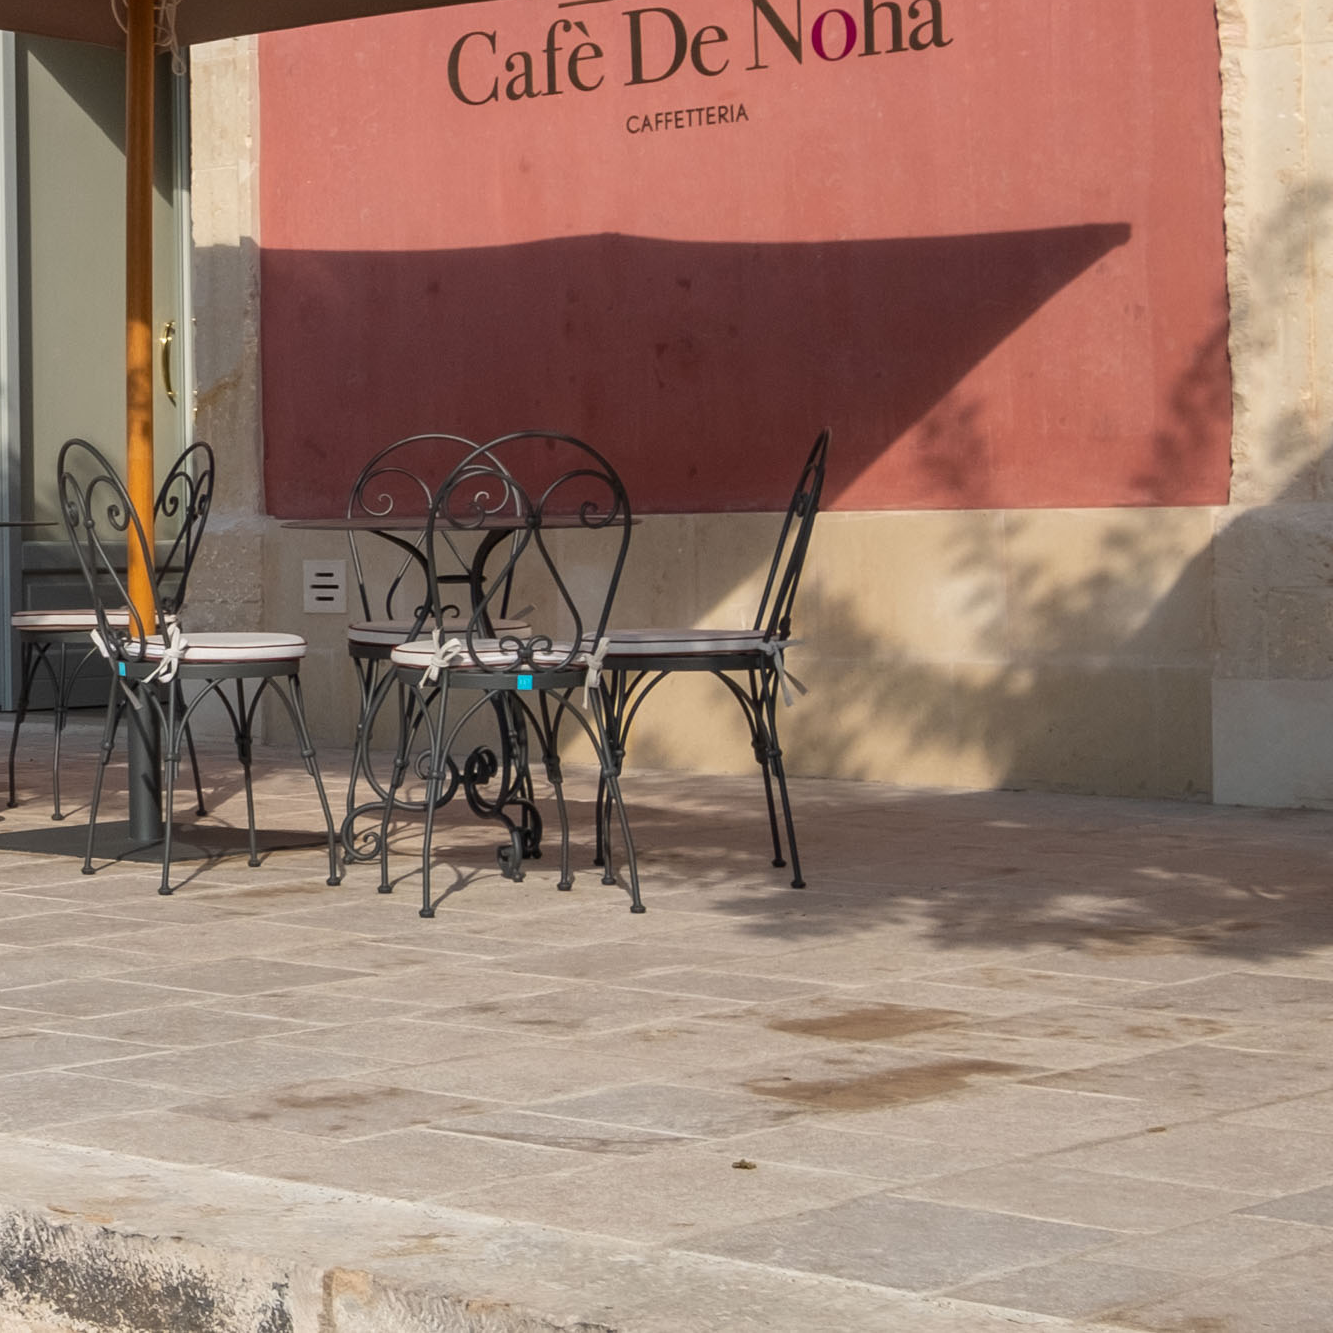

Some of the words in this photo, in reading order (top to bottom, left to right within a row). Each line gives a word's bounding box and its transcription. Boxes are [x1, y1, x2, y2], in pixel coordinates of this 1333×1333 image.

[446, 19, 605, 107] Cafè
[622, 6, 730, 87] De
[625, 103, 749, 135] CAFFETTERIA
